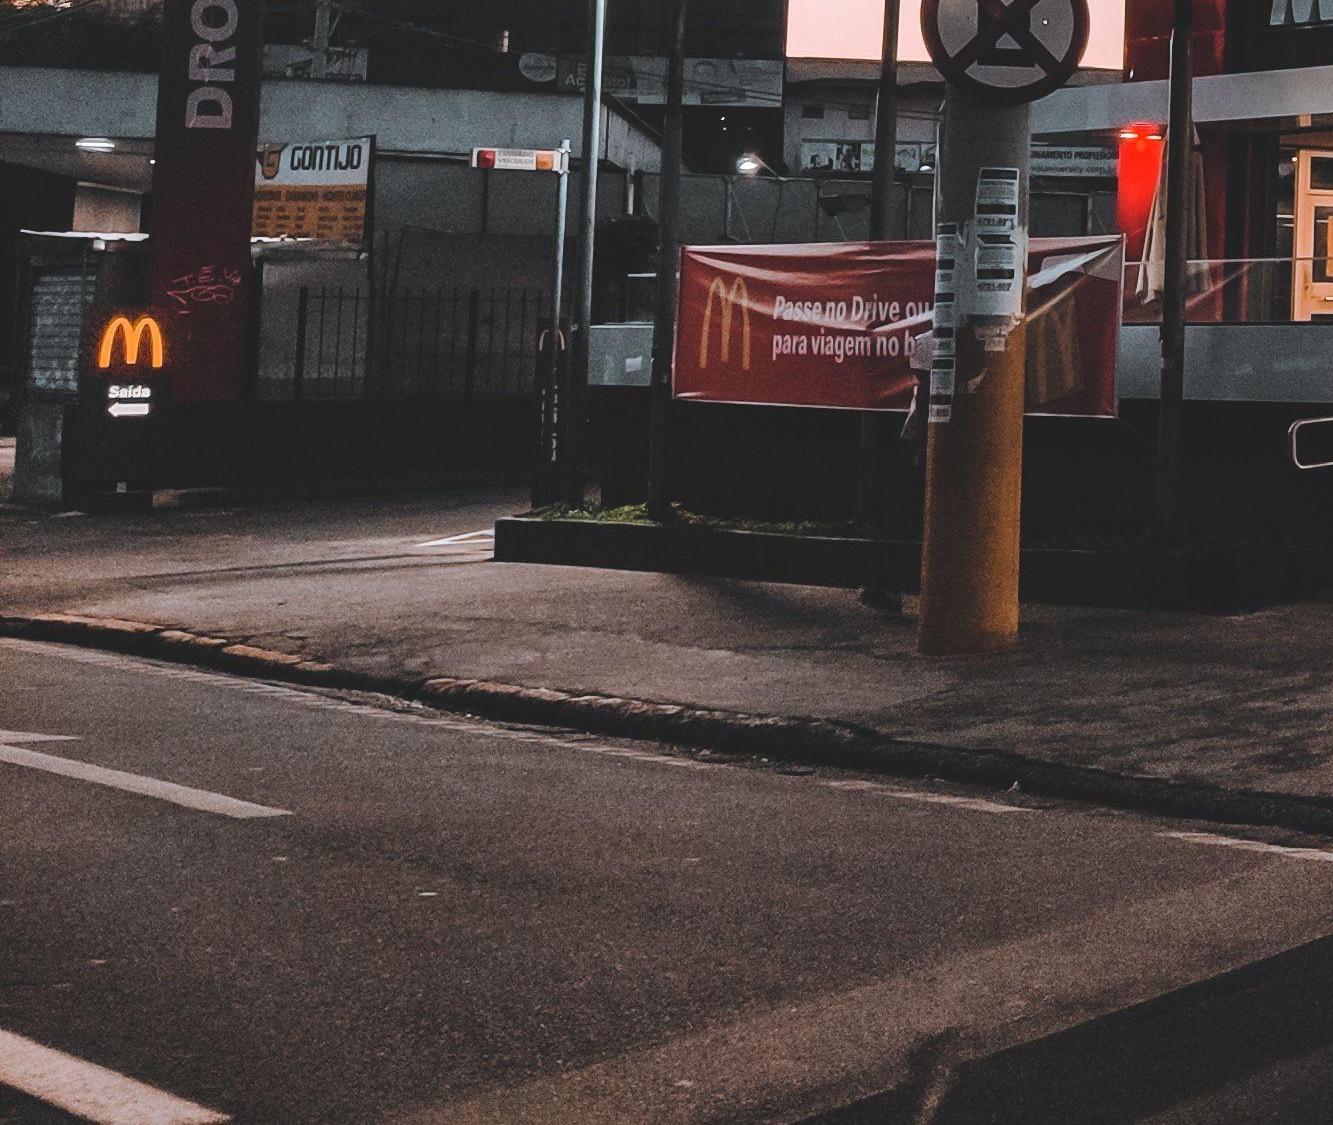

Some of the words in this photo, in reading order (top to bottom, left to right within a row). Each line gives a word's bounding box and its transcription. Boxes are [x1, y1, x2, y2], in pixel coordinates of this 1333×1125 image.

[773, 295, 823, 320] Passe
[825, 300, 847, 321] no
[851, 293, 900, 323] Drive
[773, 333, 807, 361] para
[811, 328, 871, 363] viagem
[876, 336, 899, 357] no
